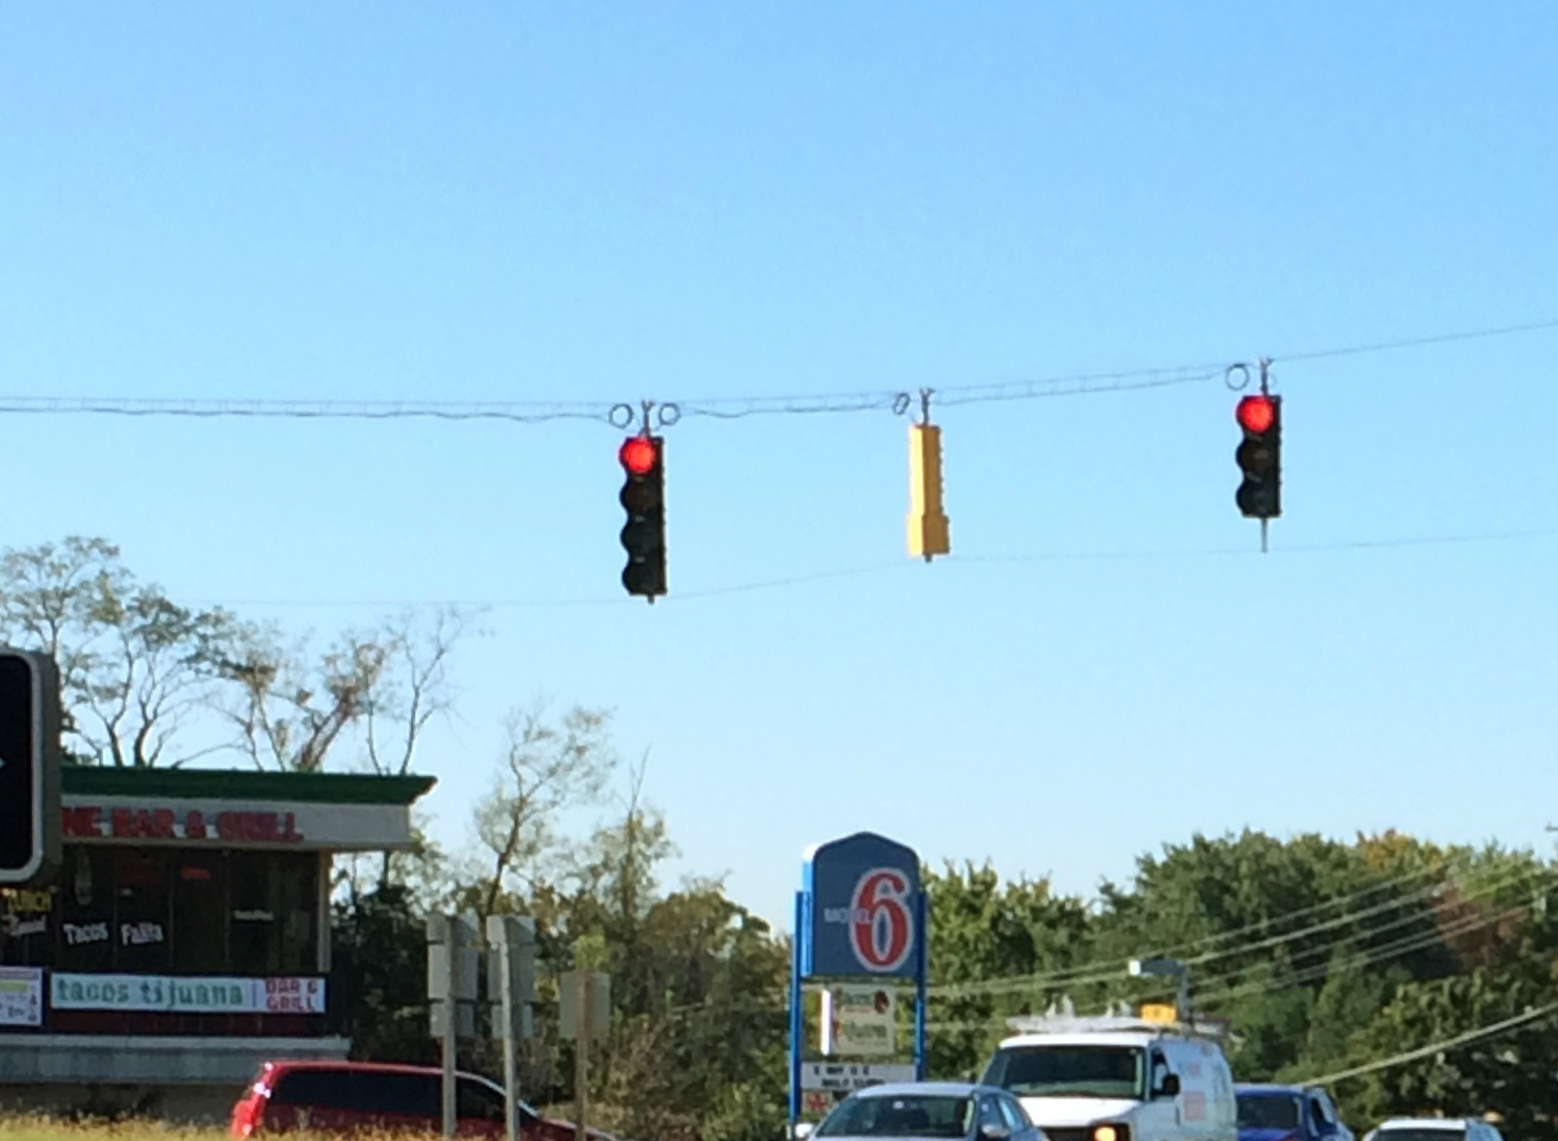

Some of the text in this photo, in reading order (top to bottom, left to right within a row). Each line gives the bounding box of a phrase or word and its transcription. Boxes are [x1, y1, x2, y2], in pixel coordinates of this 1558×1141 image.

[112, 808, 174, 838] BAR
[218, 810, 303, 842] GRILL
[848, 868, 914, 972] 6
[57, 979, 130, 1003] tacos
[140, 981, 243, 1009] tijuana
